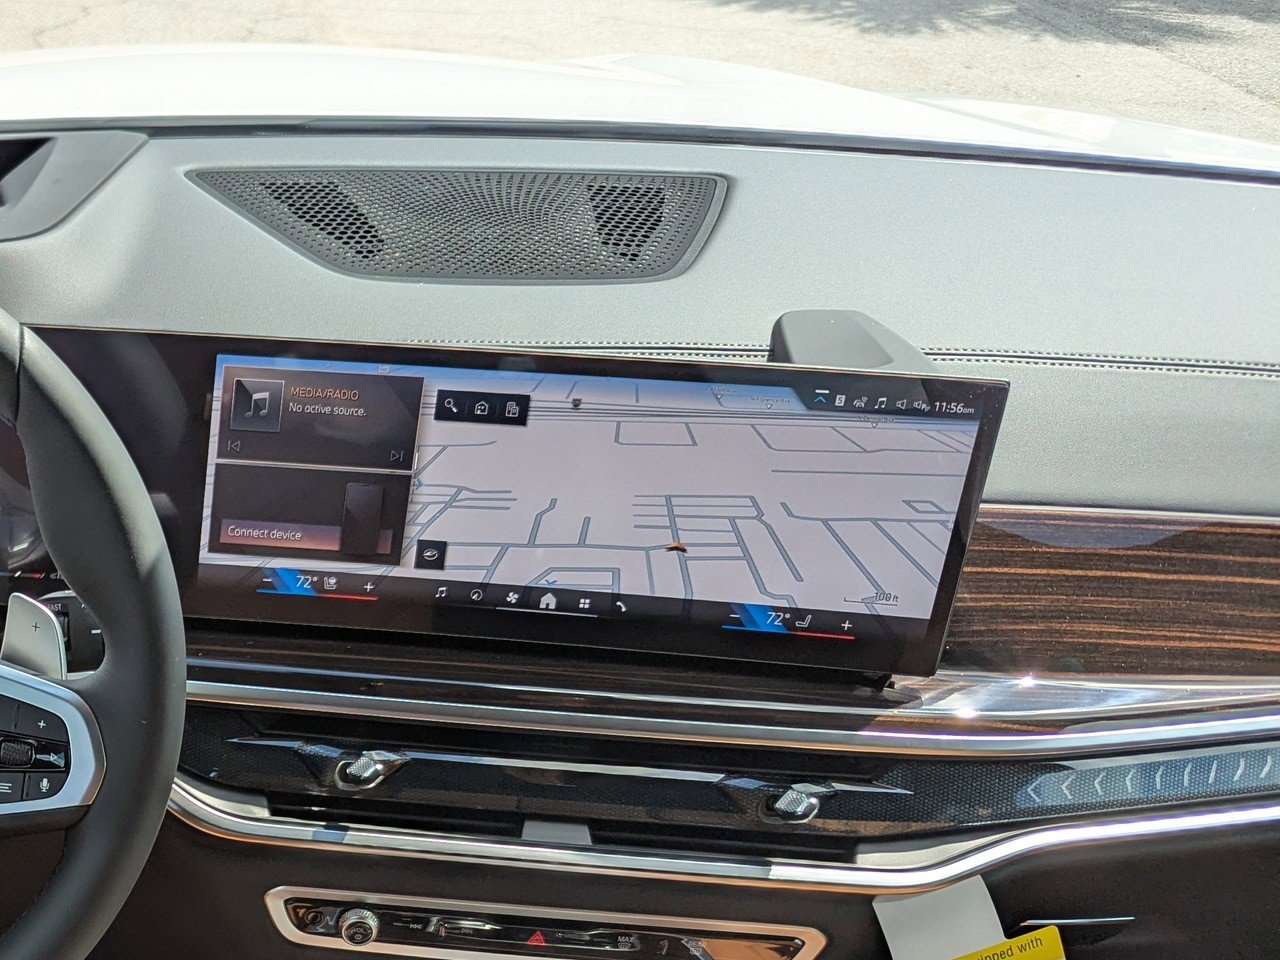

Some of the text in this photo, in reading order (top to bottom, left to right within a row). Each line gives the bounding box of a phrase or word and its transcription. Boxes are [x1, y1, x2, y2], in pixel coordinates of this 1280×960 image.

[290, 386, 359, 401] MEDIA/RADIO
[289, 402, 367, 417] No active source.
[227, 525, 302, 541] Connect device
[874, 592, 892, 602] 100
[617, 935, 634, 943] MAX
[1016, 936, 1044, 954] with
